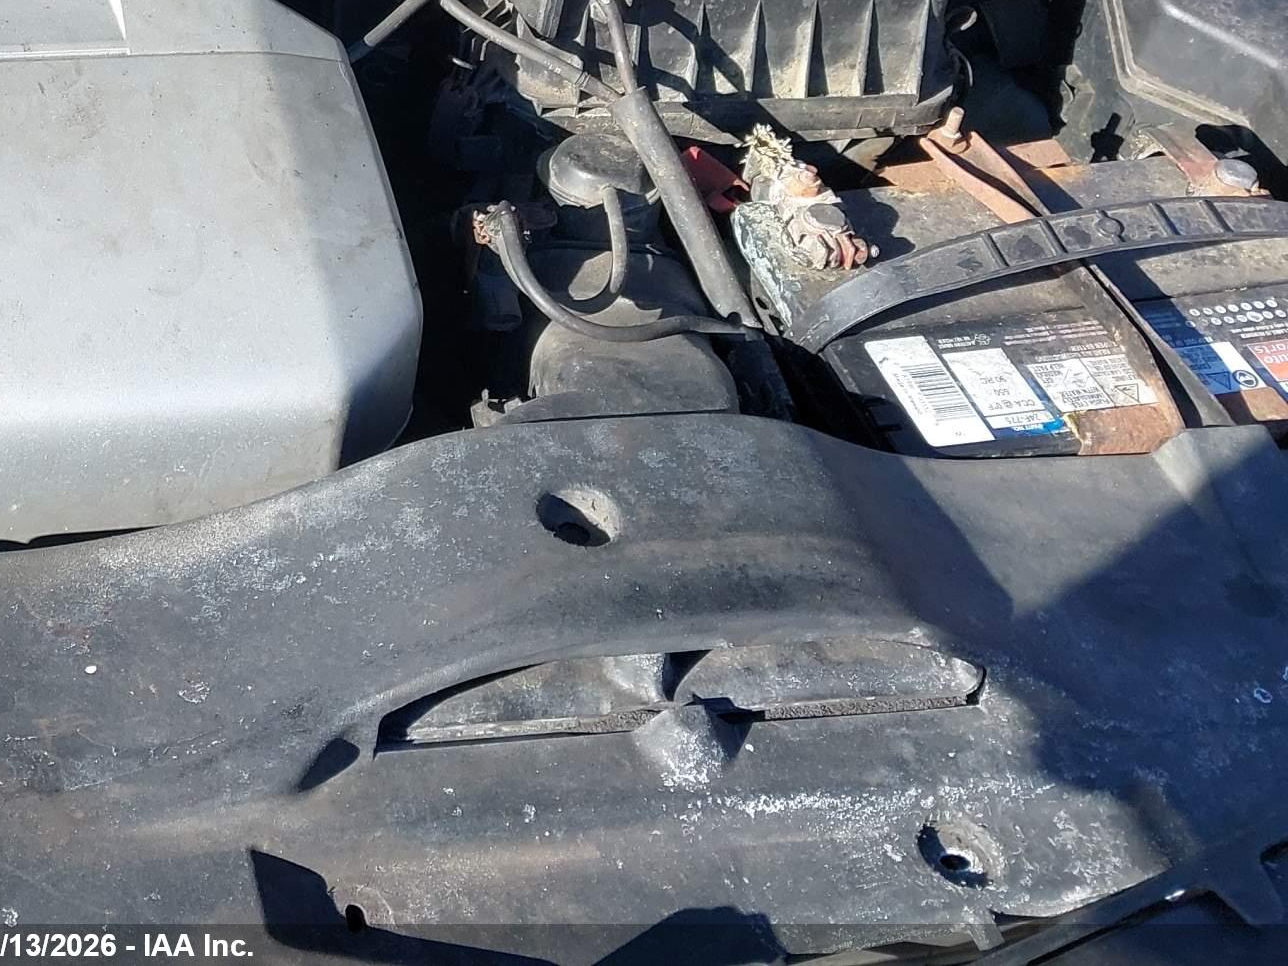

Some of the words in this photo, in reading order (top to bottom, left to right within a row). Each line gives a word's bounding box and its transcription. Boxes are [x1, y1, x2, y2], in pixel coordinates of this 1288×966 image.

[1253, 343, 1288, 355] arts
[1263, 353, 1288, 365] uto
[1013, 398, 1036, 408] CCA
